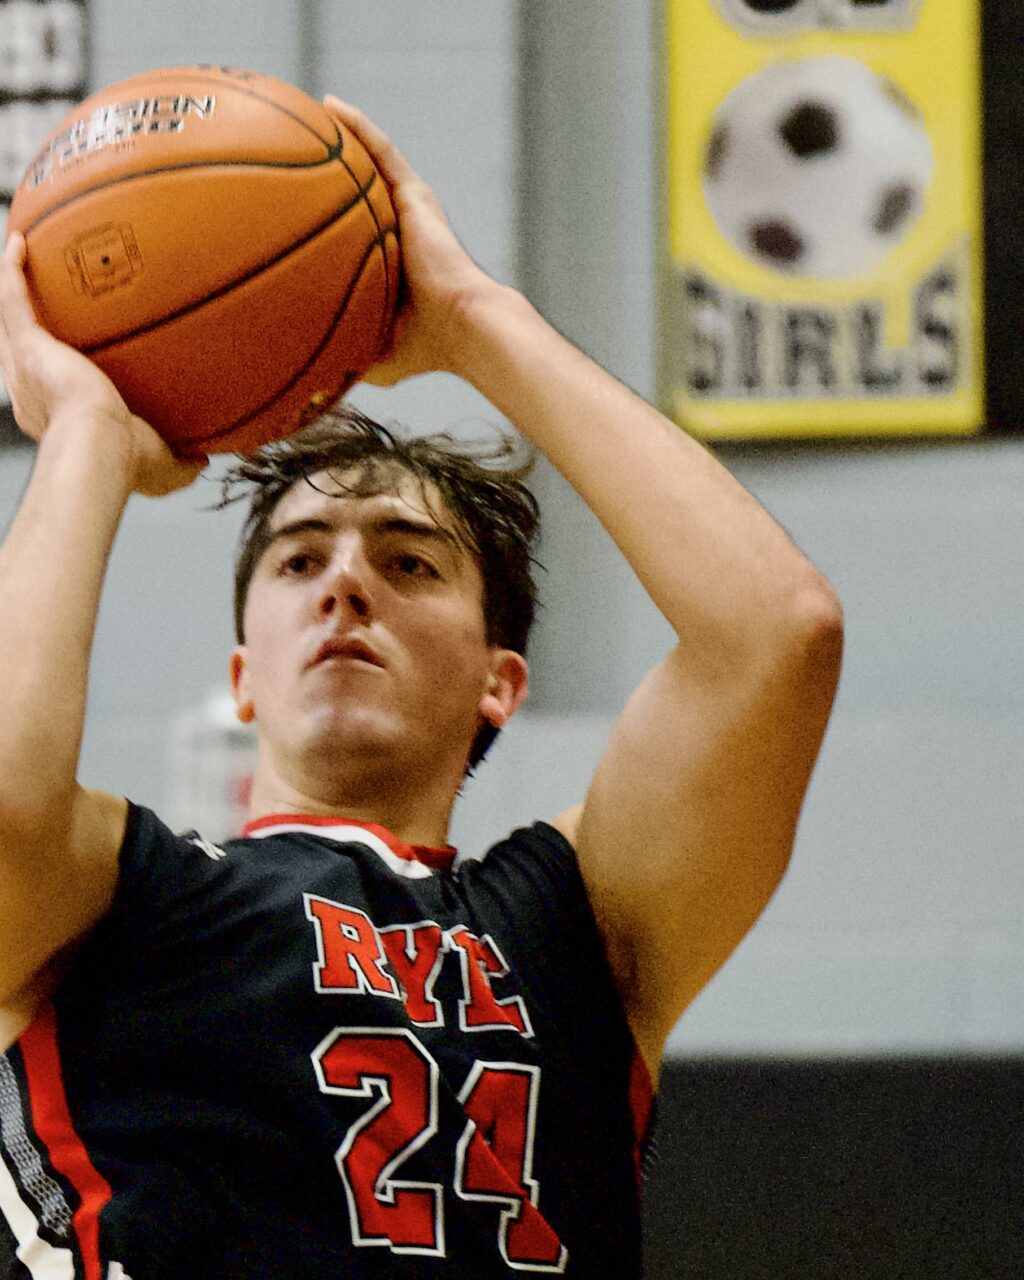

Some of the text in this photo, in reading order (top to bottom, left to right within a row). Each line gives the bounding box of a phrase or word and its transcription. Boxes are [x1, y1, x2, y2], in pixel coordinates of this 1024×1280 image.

[679, 248, 960, 396] GIRLS
[302, 890, 535, 1039] RYE
[309, 1025, 569, 1274] 24
